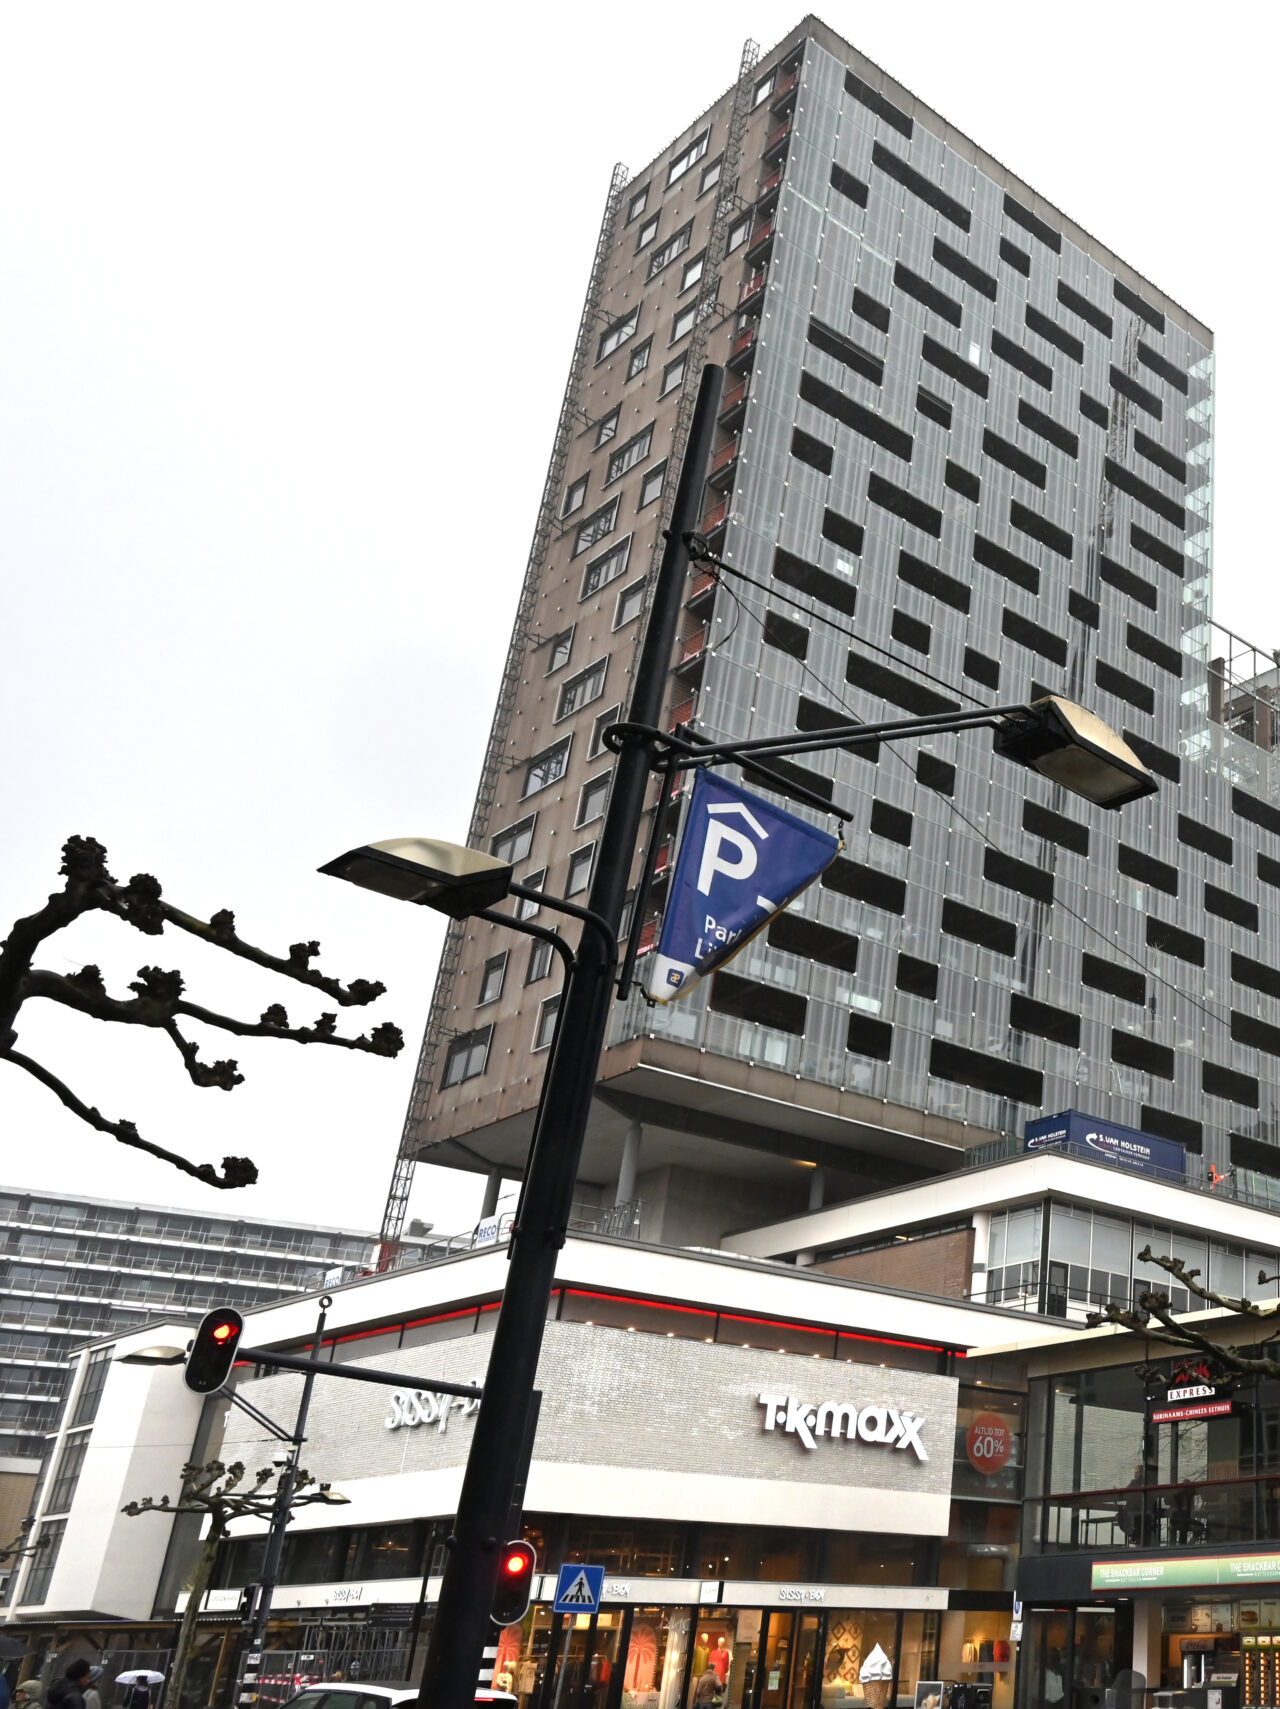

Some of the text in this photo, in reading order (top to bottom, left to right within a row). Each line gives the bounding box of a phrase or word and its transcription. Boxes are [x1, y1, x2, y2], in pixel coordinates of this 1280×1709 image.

[697, 818, 757, 897] P
[1120, 1140, 1151, 1156] HOLSTEIN
[479, 1223, 497, 1240] RECO
[1169, 1386, 1214, 1400] EXPRESS
[975, 1426, 1005, 1437] ALTIJD TOT
[973, 1436, 1004, 1458] 60%
[1100, 1566, 1164, 1578] THE SNACKBAR CORNER
[1230, 1563, 1242, 1573] THE
[1243, 1561, 1277, 1571] SNACKBAR
[779, 1586, 826, 1604] SISSY-BOY
